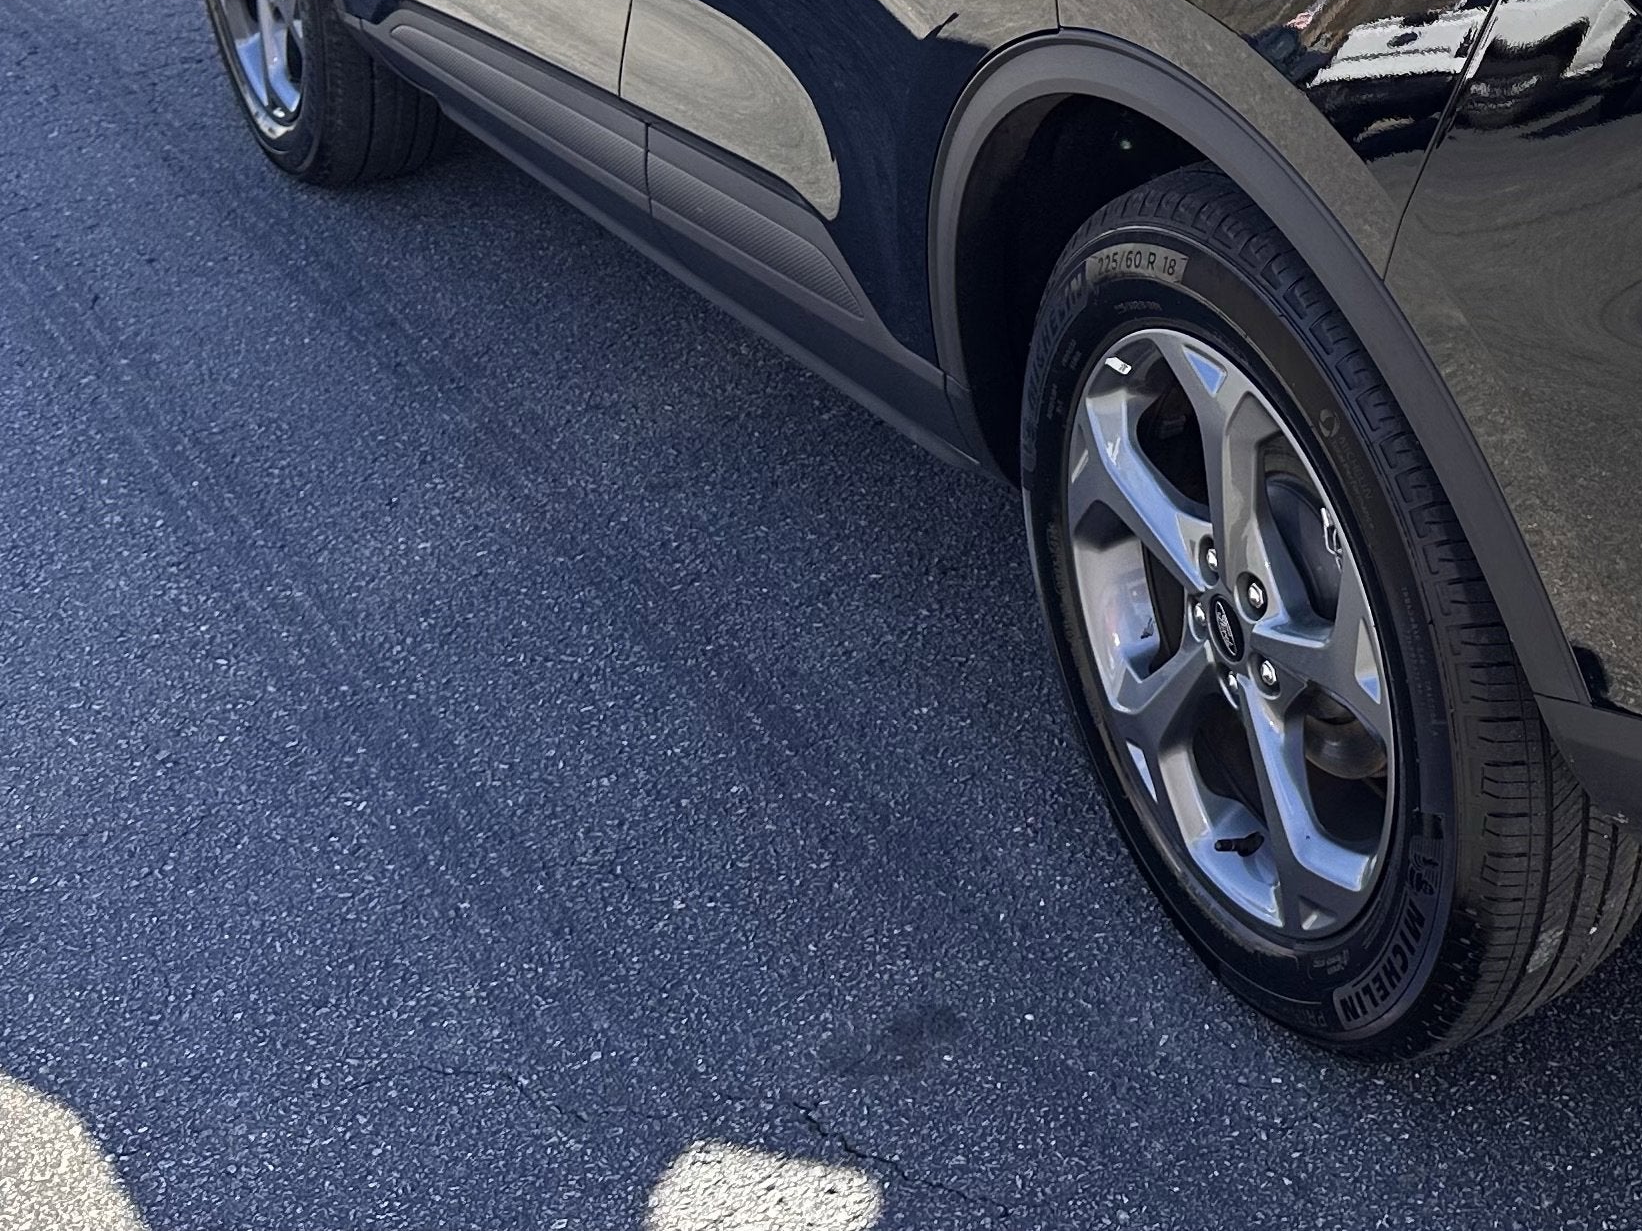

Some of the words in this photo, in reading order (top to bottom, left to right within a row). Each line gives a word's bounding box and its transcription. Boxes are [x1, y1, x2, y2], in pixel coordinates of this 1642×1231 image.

[1097, 250, 1143, 276] 225/60
[1146, 251, 1157, 271] R
[1162, 256, 1177, 276] 18
[1340, 897, 1426, 1023] MICHELIN
